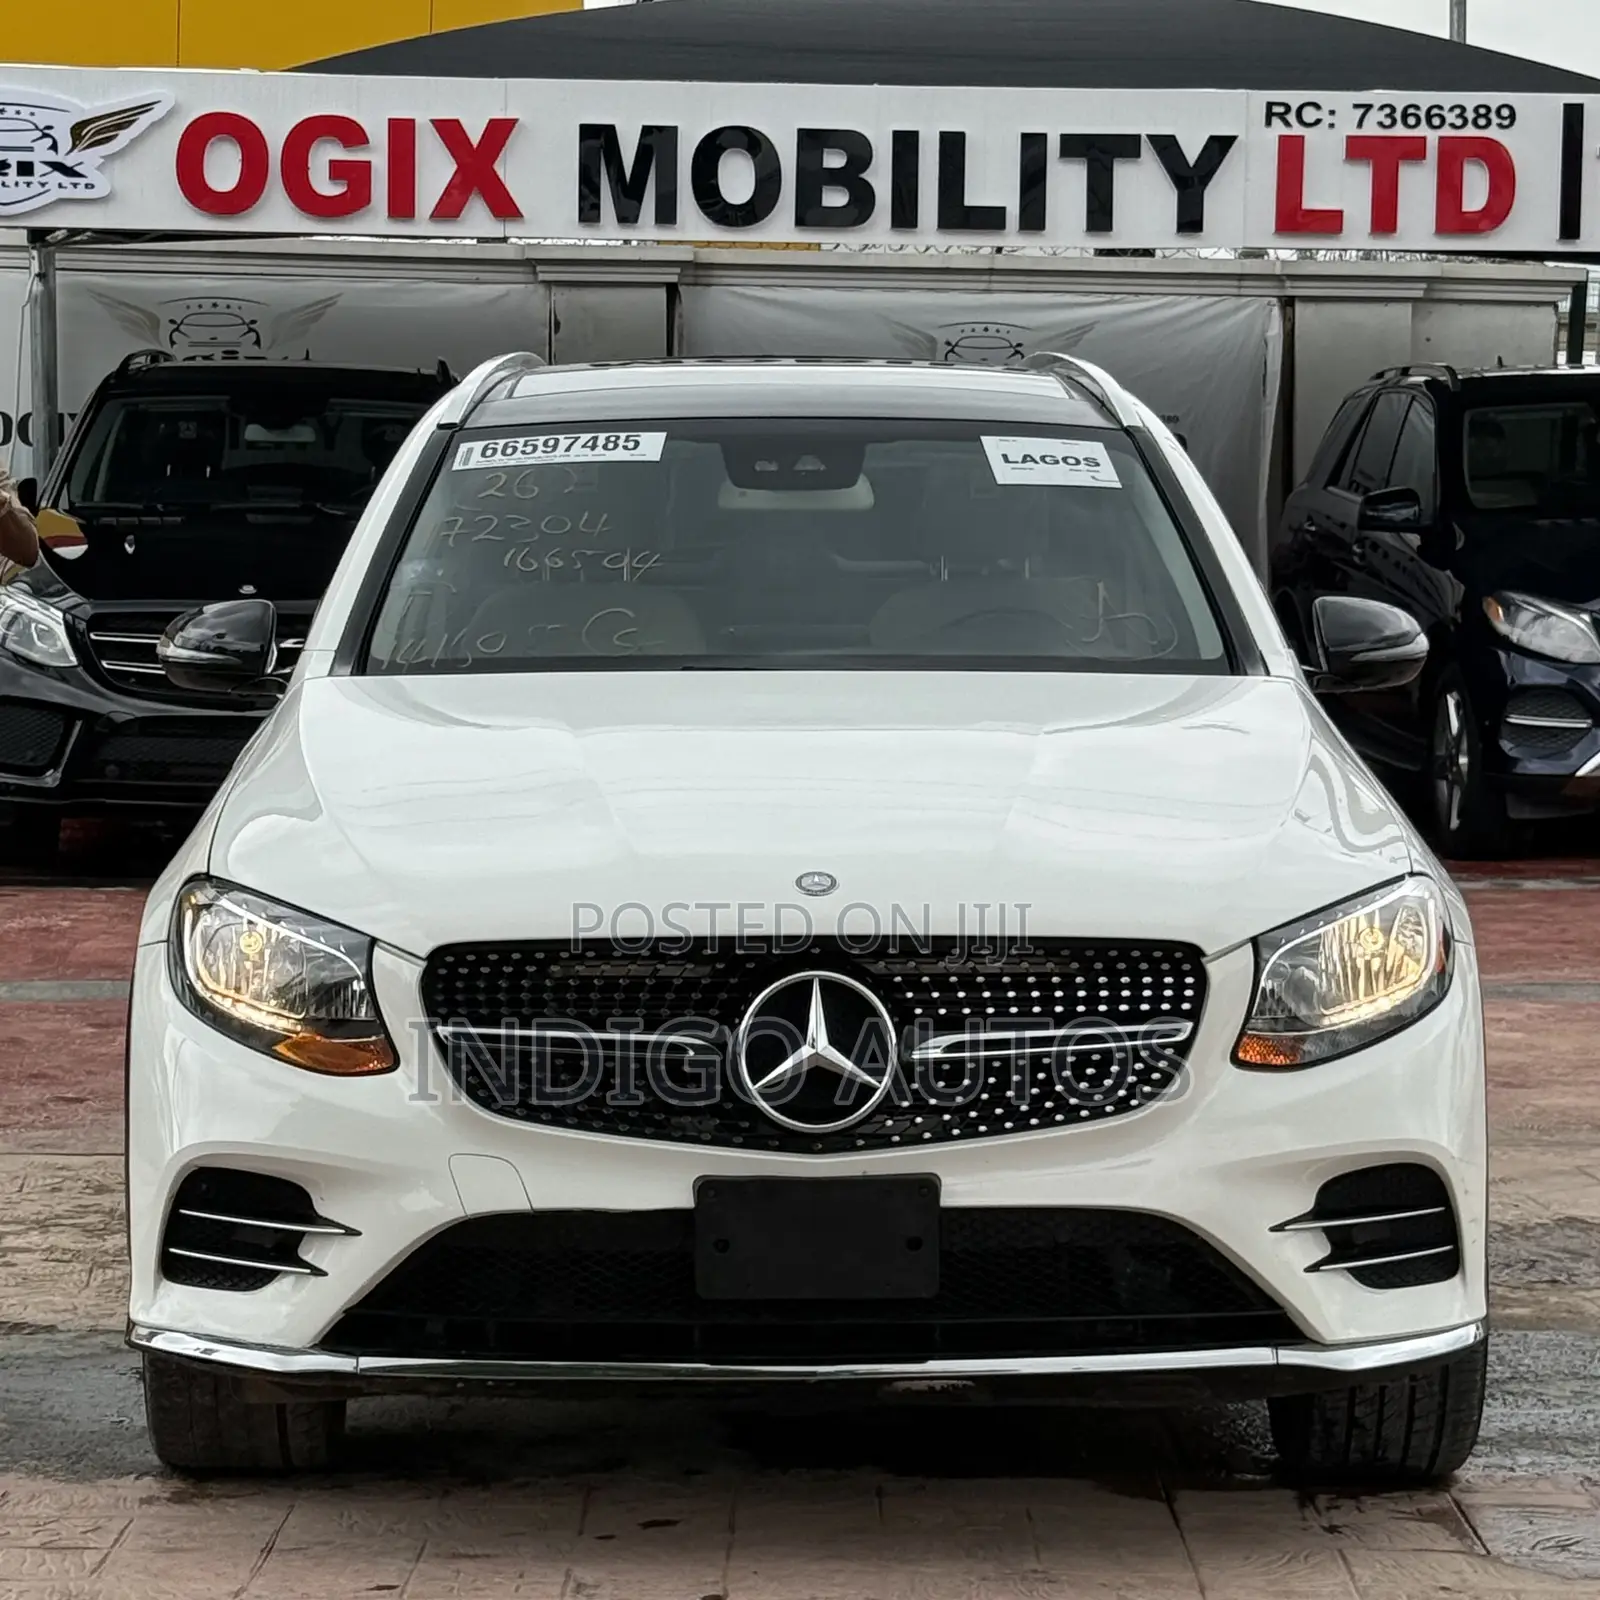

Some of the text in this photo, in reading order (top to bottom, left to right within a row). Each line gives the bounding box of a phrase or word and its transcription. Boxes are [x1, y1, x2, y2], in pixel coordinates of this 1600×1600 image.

[1264, 101, 1517, 130] RC: 7366389
[176, 111, 524, 220] OGIX
[578, 123, 1239, 234] MOBILITY
[1274, 134, 1516, 235] LTD
[58, 182, 96, 190] LTD
[480, 434, 642, 459] 66597485
[1001, 453, 1101, 467] LAGOS
